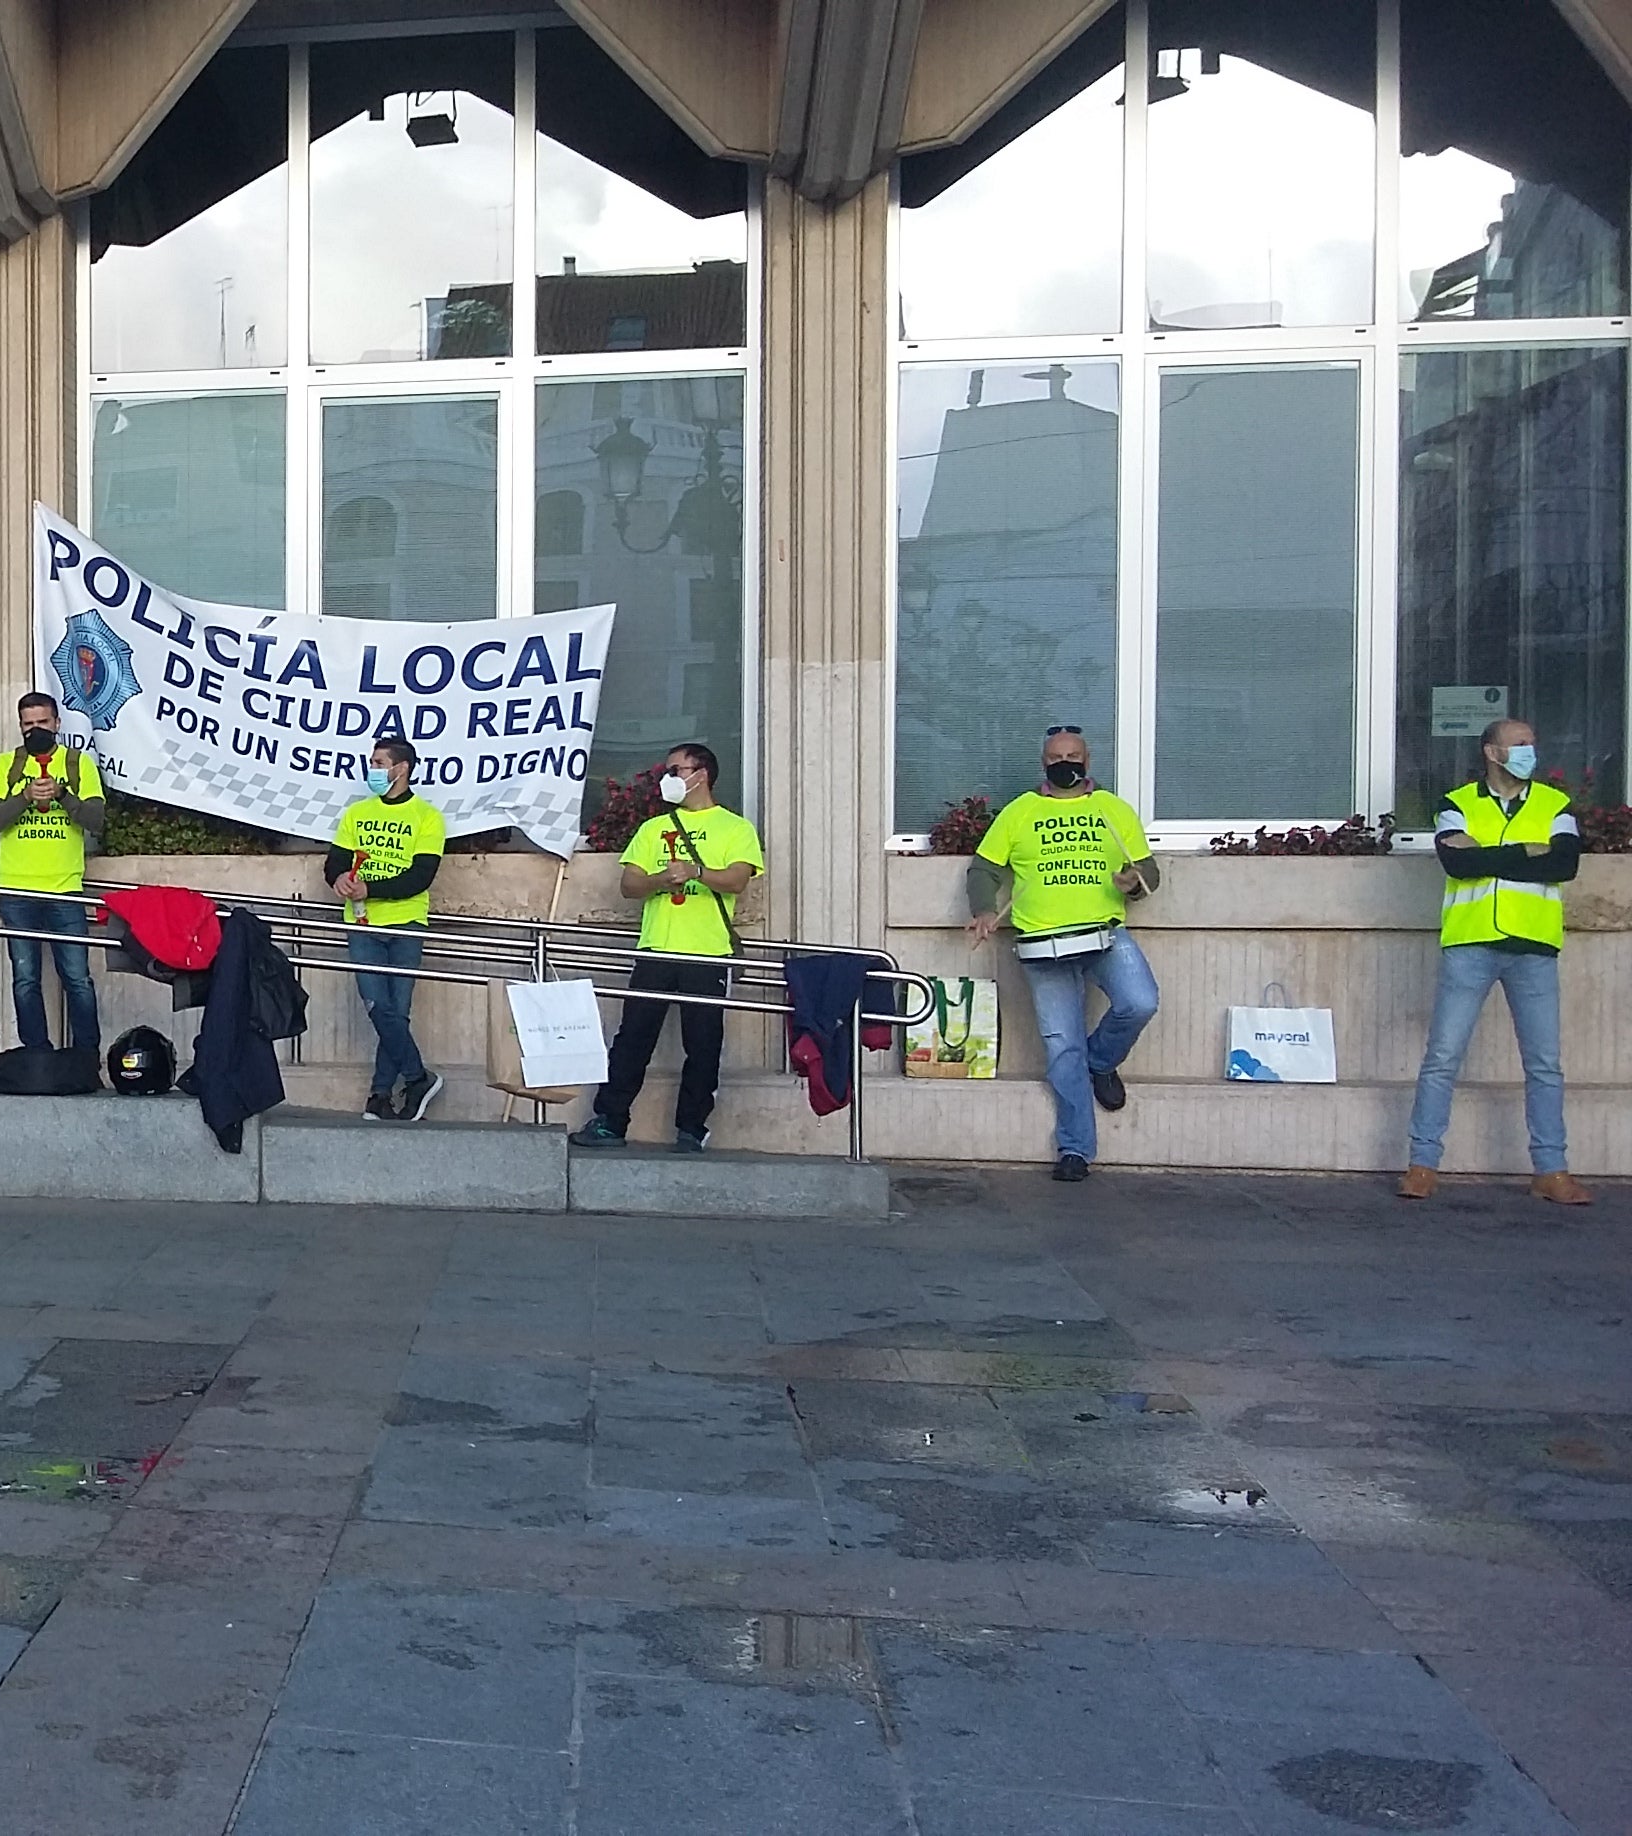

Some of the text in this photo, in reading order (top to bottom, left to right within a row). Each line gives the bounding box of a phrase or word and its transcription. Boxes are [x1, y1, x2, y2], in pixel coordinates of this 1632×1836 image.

[47, 529, 601, 694] POLICÍA LOCAL
[163, 650, 593, 741] DE CIUDAD REAL
[155, 696, 588, 786] POR UN SERVCIO DIGNO
[98, 752, 128, 778] EAL
[14, 815, 71, 826] ONFLICTO
[356, 820, 412, 836] POLICÍA
[1034, 814, 1107, 832] POLICÍA
[18, 829, 66, 840] LABORAL
[359, 834, 404, 850] LOCAL
[1041, 830, 1103, 845] LOCAL
[1040, 845, 1104, 856] CIUDAD REAL
[1037, 859, 1107, 872] CONFLICTO
[1044, 874, 1102, 886] LABORAL
[1255, 1031, 1310, 1043] mayoral
